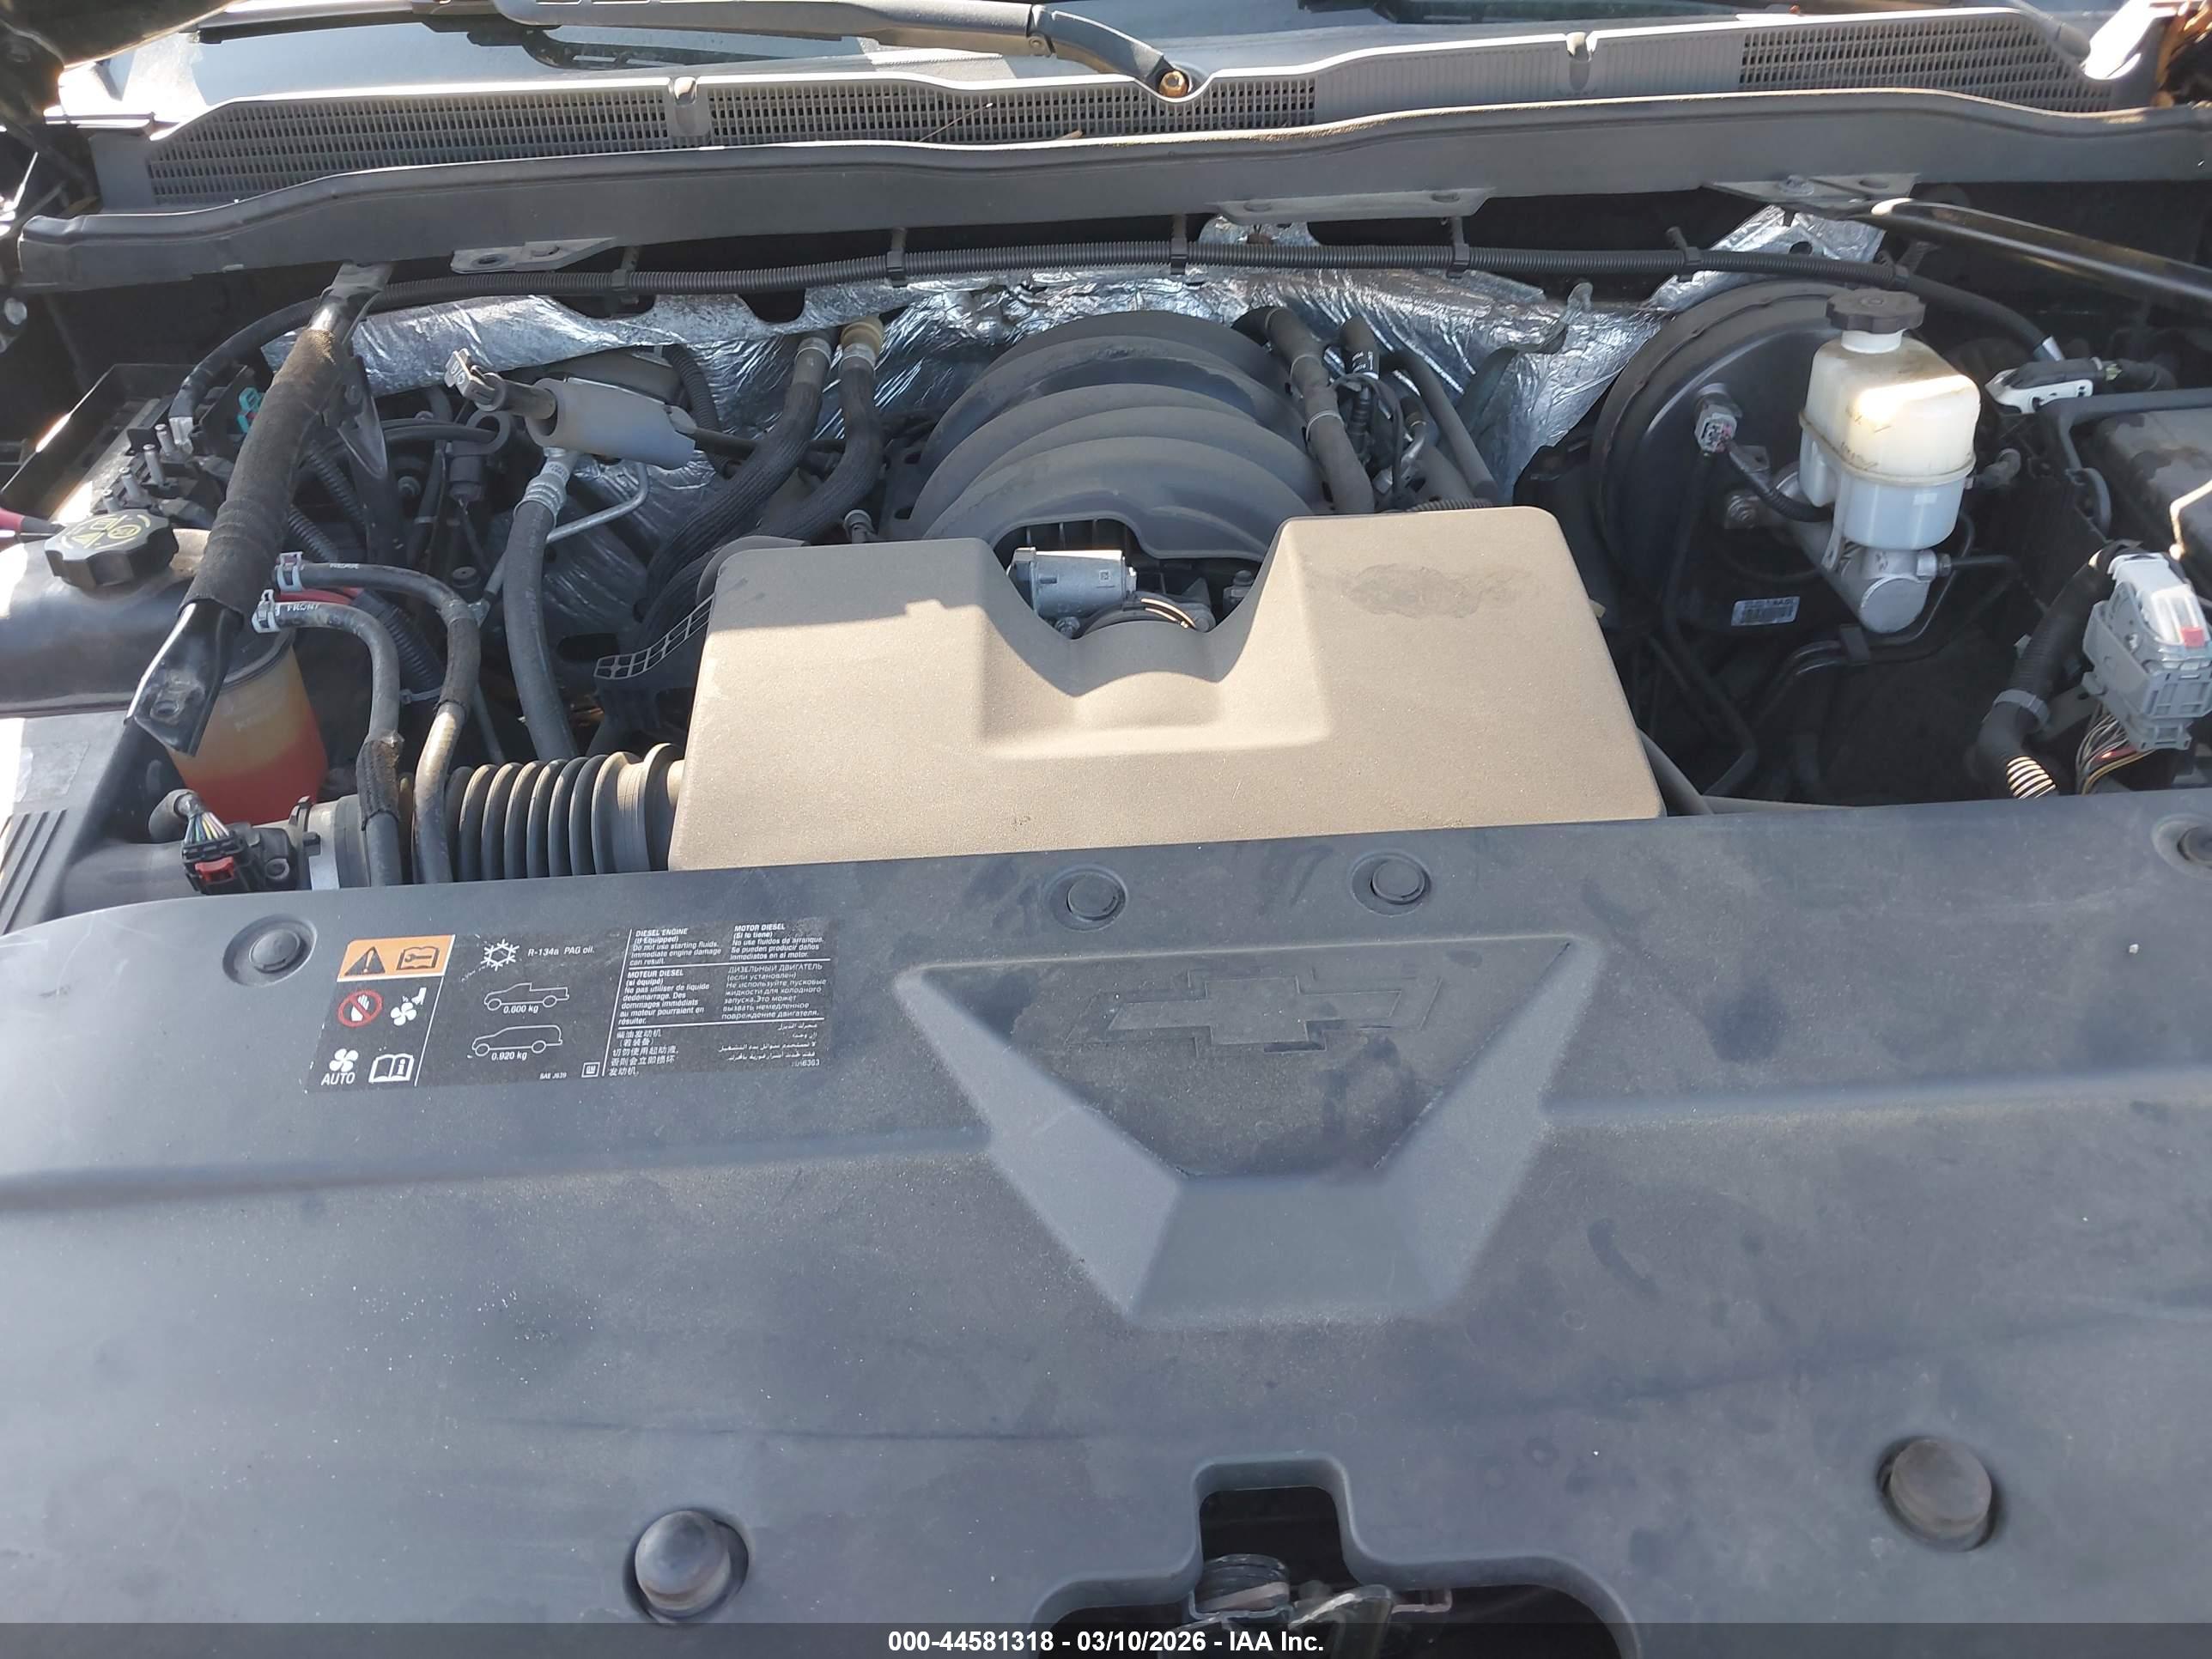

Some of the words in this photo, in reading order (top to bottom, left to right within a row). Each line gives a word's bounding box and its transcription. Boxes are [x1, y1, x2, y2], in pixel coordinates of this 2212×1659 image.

[644, 936, 679, 944] Equipped)
[528, 948, 559, 957] R-134a
[742, 945, 767, 954] pueden
[779, 963, 823, 972] ДВИГАТЕЛЬ
[750, 972, 796, 980] установлен)
[528, 1005, 539, 1013] kg
[622, 1001, 660, 1009] dommages
[658, 1007, 693, 1016] pourraient
[491, 1052, 515, 1060] 0.920
[517, 1051, 527, 1060] kg
[321, 1071, 355, 1086] AUTO
